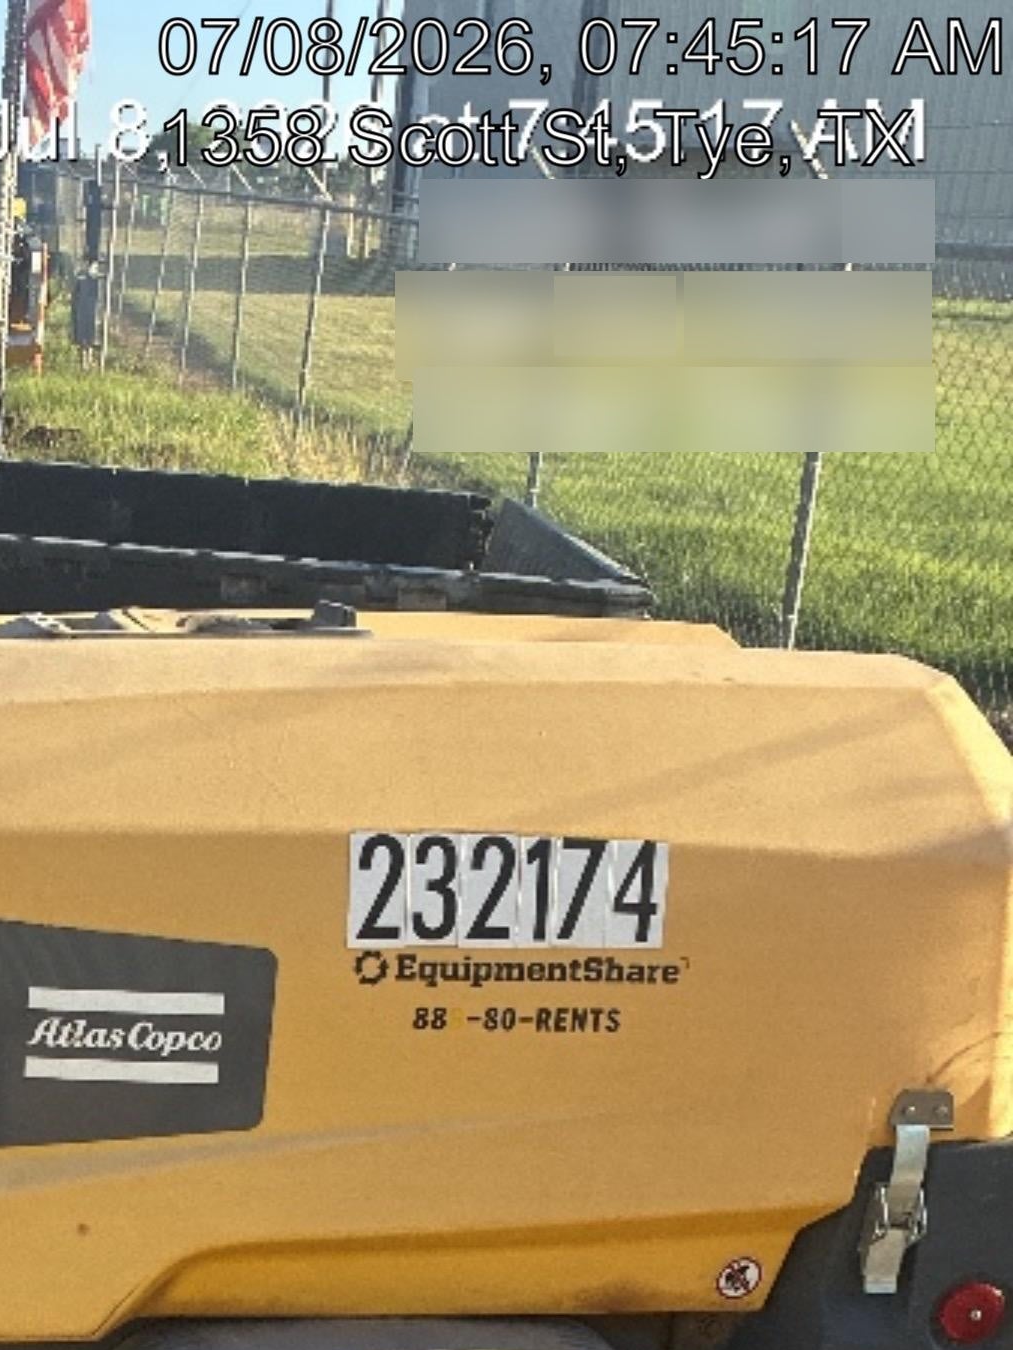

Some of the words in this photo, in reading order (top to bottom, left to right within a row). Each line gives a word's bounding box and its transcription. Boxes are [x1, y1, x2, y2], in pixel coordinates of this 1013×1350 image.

[356, 834, 658, 943] 232174
[395, 954, 680, 987] EquipmentShare
[26, 1016, 125, 1049] Atlas
[127, 1020, 223, 1057] Copco
